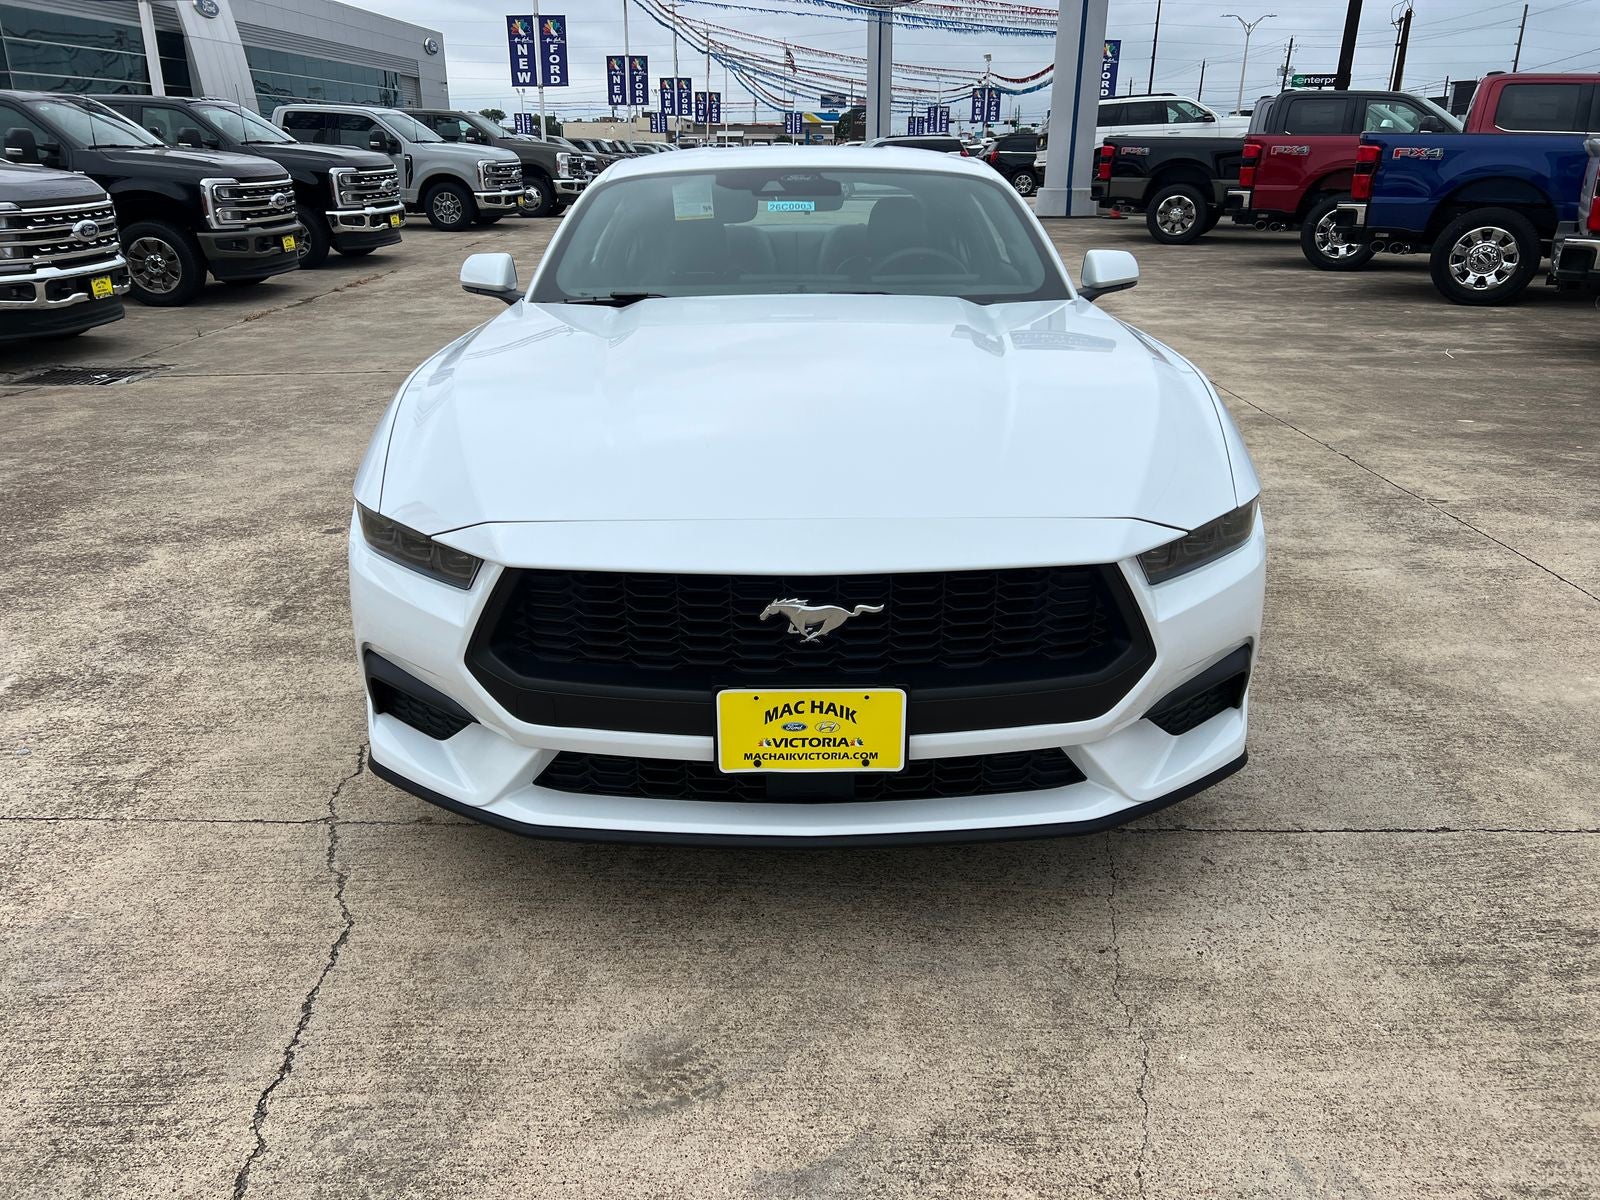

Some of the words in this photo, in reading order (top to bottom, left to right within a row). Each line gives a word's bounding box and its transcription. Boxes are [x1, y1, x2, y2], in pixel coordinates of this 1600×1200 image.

[517, 44, 531, 83] NEW
[549, 44, 561, 84] FORD
[612, 75, 622, 103] NEW
[635, 75, 643, 104] FORD
[1101, 63, 1111, 96] FORD
[1293, 76, 1336, 86] enterpr
[664, 92, 673, 114] NEW
[697, 104, 705, 121] NEW
[974, 101, 982, 121] NEW
[1121, 146, 1150, 156] FX4
[1271, 145, 1310, 156] FX4
[1392, 147, 1444, 159] FX4
[764, 701, 805, 725] MAC
[810, 700, 858, 724] HAIK
[771, 737, 850, 748] VICTORIA
[743, 751, 879, 761] MACHAIKVICTORIA.COM
